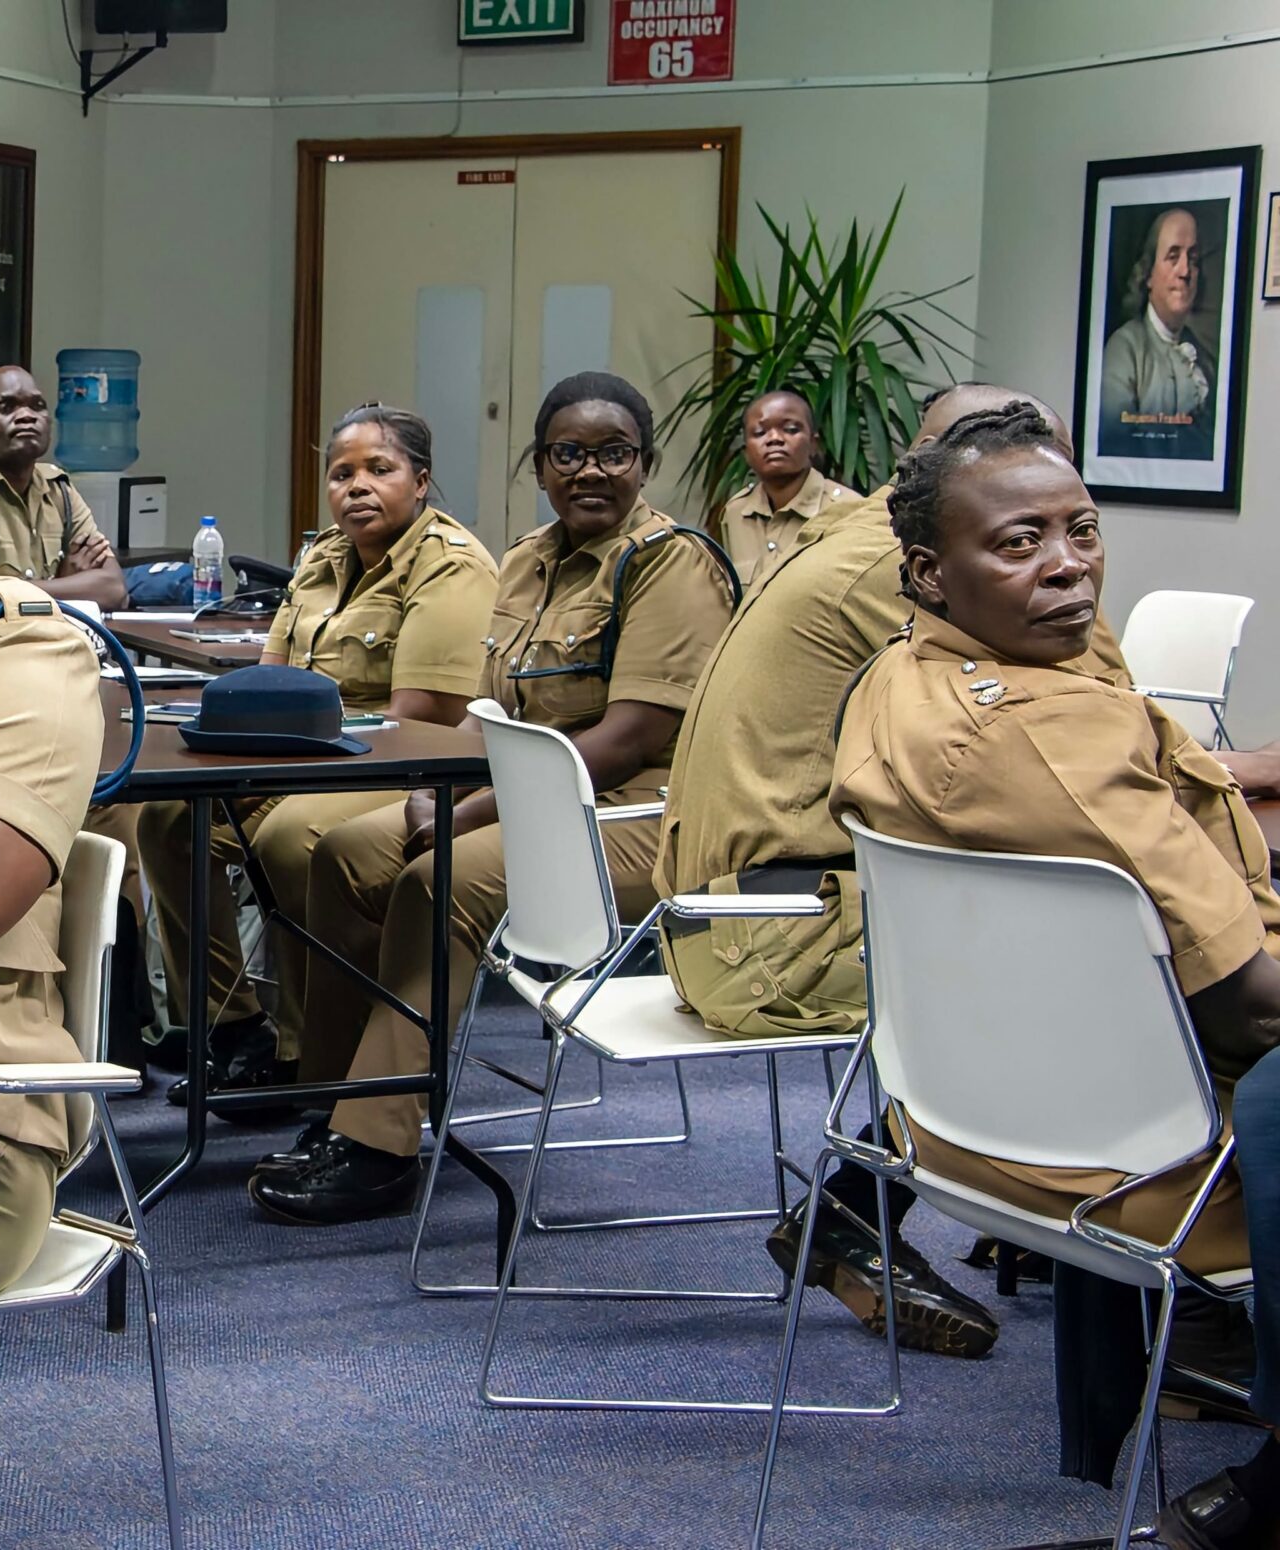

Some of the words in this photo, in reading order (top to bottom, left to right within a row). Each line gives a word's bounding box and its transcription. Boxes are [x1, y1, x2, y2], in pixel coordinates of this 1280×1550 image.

[473, 0, 556, 27] EXIT
[630, 0, 716, 19] MAXIMUM
[621, 16, 724, 39] OCCUPANCY
[648, 40, 694, 79] 65
